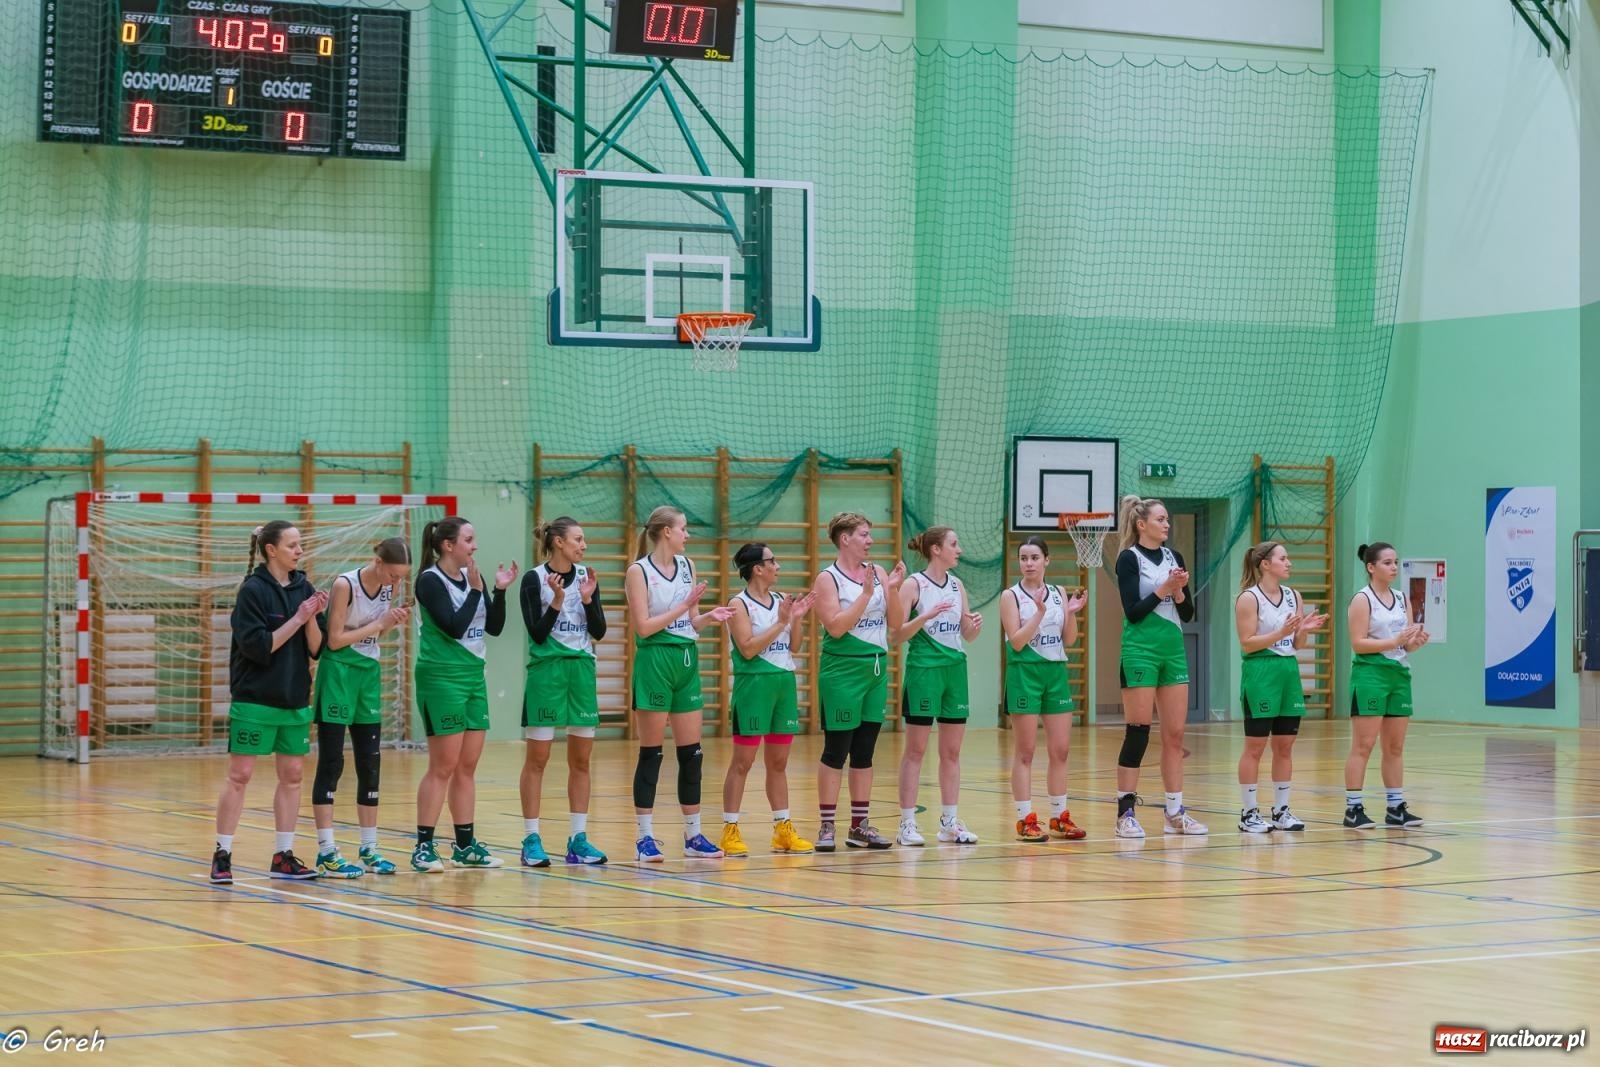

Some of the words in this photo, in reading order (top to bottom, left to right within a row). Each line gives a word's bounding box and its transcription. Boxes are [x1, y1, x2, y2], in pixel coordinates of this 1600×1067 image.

[188, 1, 214, 10] CZAS
[222, 3, 249, 13] CZAS
[251, 5, 272, 14] GRY
[122, 23, 136, 43] 0
[319, 36, 332, 55] 0
[122, 71, 213, 93] GOSPODARZE
[261, 76, 312, 99] GOŚCIE
[133, 103, 154, 132] 0
[202, 115, 226, 130] 3D
[285, 112, 304, 141] 0
[1509, 577, 1530, 597] UNIA
[1520, 672, 1529, 680] DO
[538, 707, 557, 722] 14
